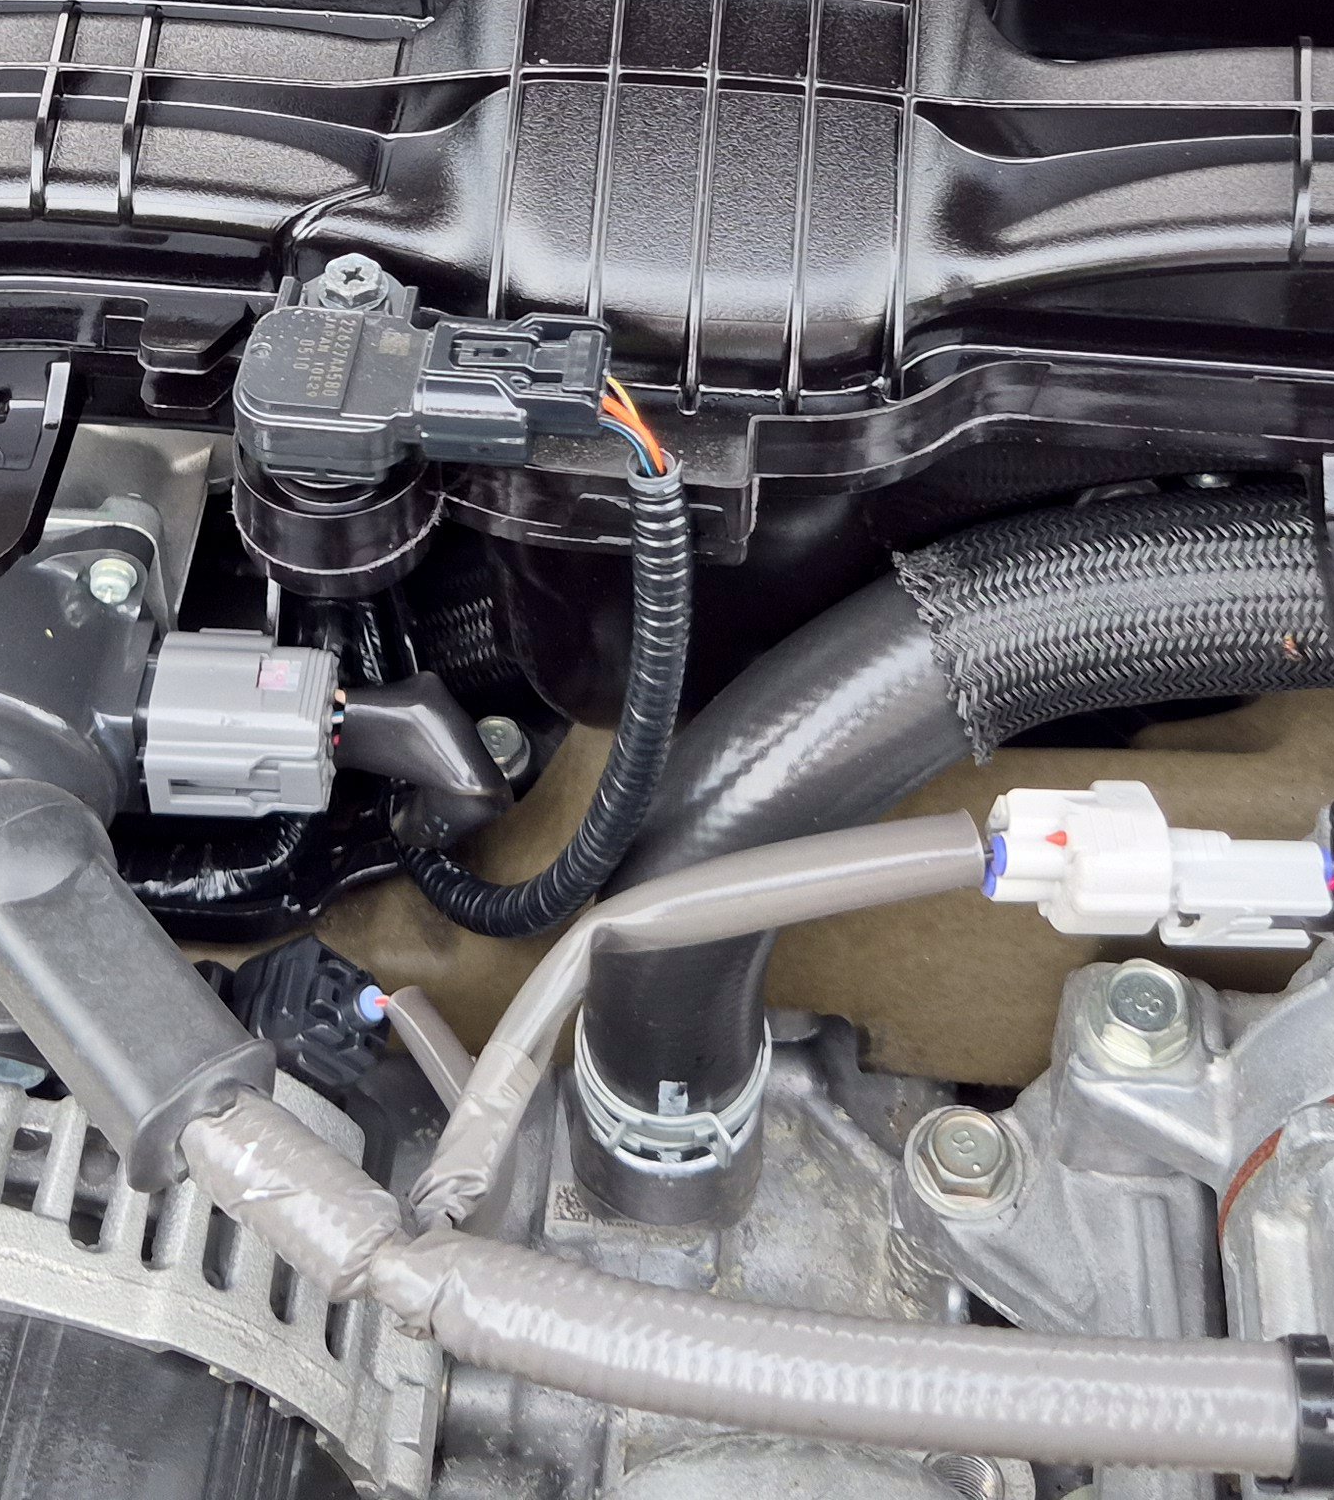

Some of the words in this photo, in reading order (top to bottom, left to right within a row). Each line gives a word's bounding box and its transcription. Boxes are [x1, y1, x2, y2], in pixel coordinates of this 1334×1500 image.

[317, 315, 337, 352] JAPAN
[293, 339, 315, 370] 0510
[322, 319, 357, 396] 22627AA580
